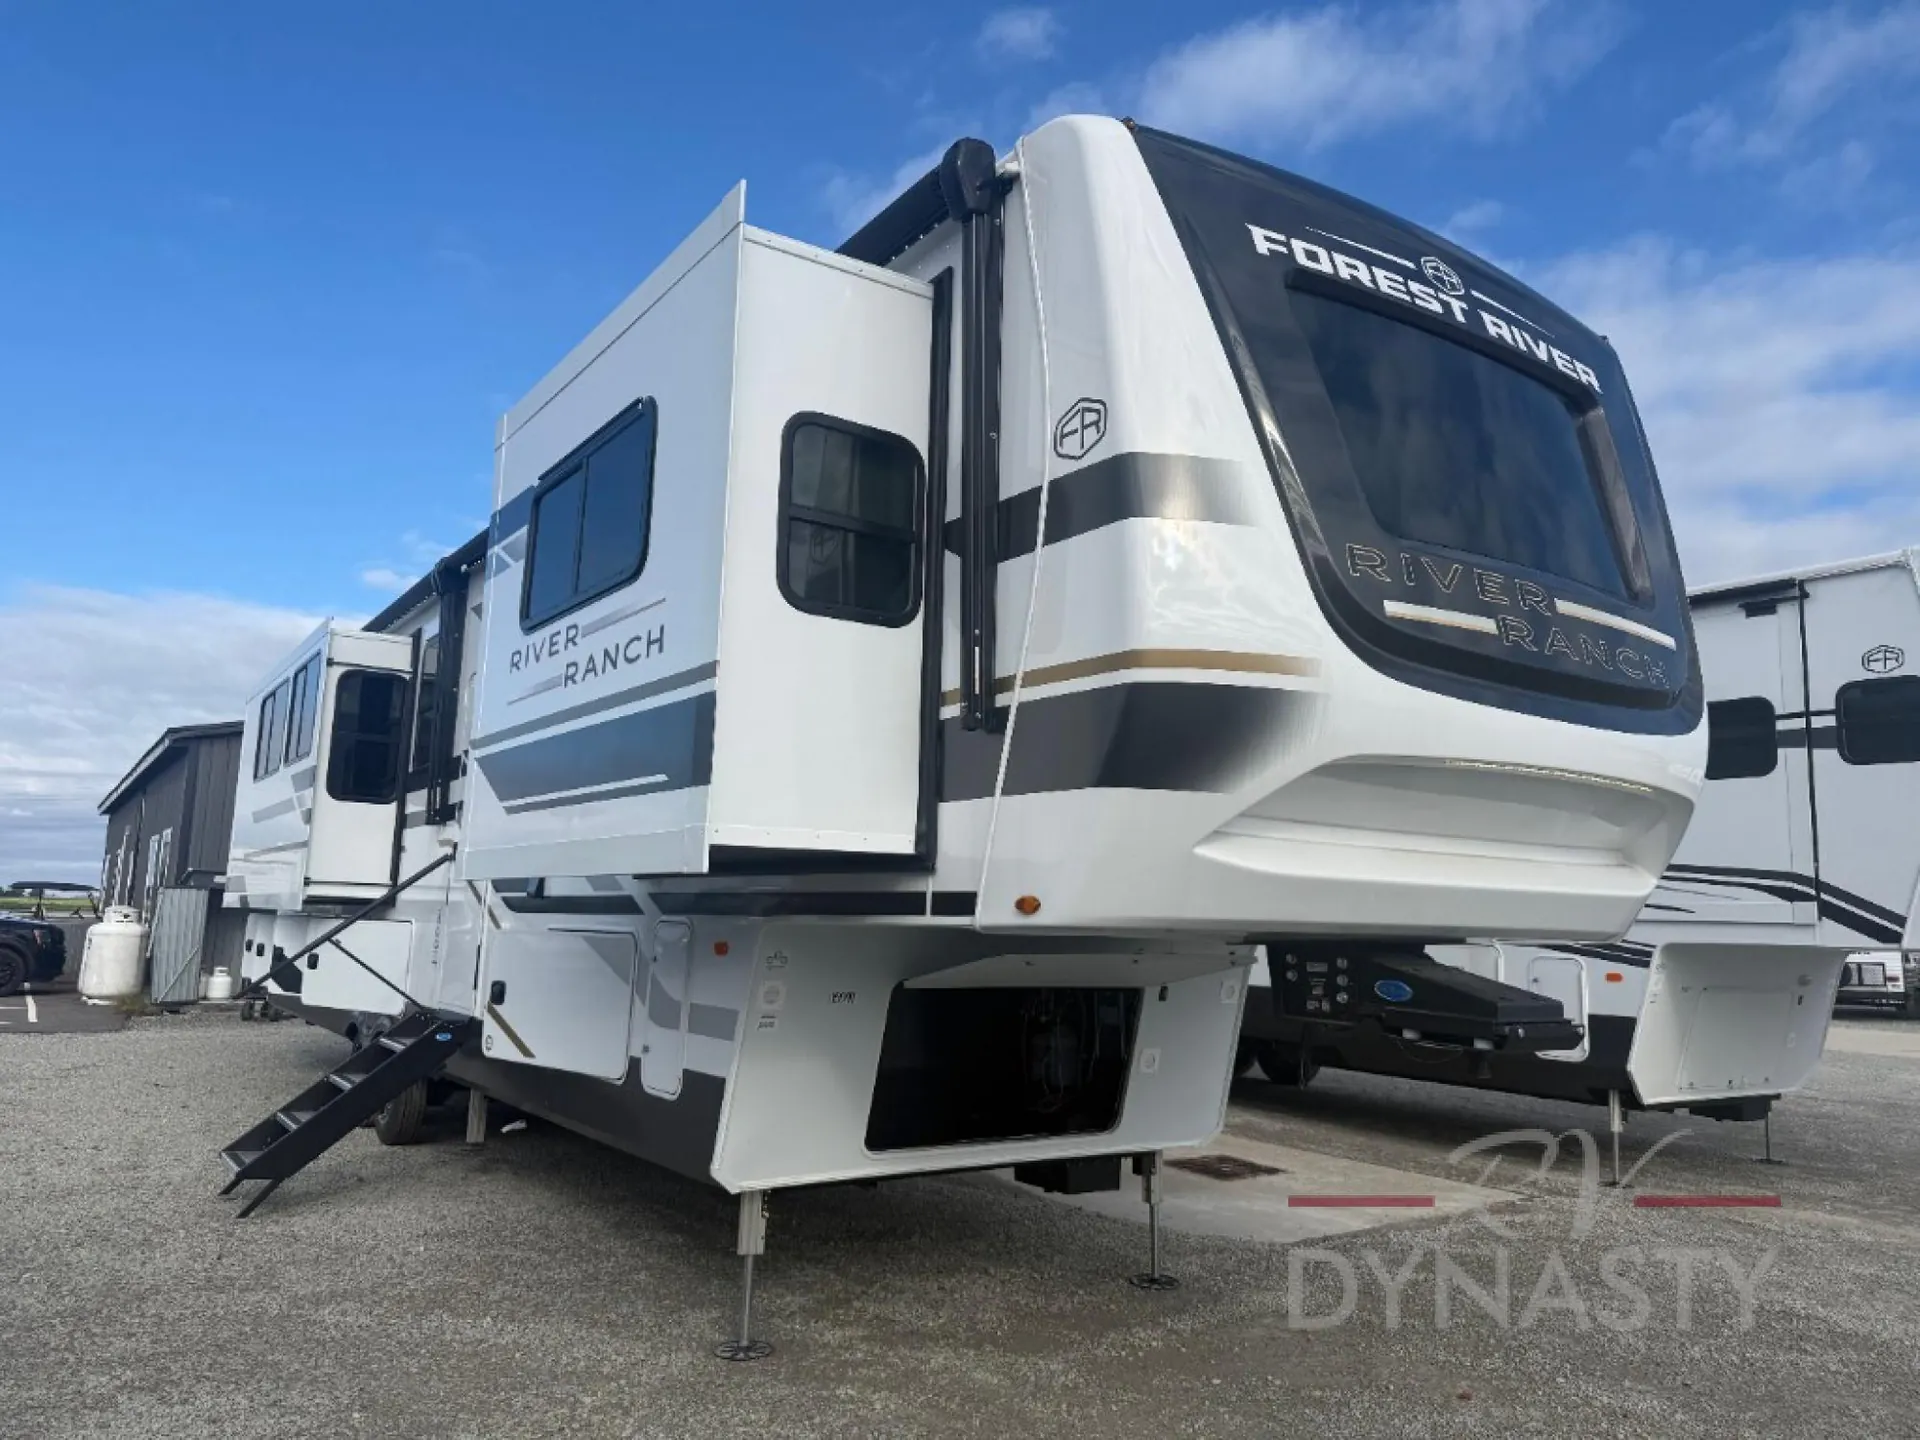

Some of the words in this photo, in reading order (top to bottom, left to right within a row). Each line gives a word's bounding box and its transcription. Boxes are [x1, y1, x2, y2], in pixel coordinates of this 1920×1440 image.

[1245, 222, 1469, 323] FOREST
[1480, 308, 1603, 395] RIVER
[1345, 543, 1551, 616] RIVER
[510, 623, 579, 674] RIVER
[564, 624, 665, 688] RANCH
[1498, 615, 1671, 689] RANCH
